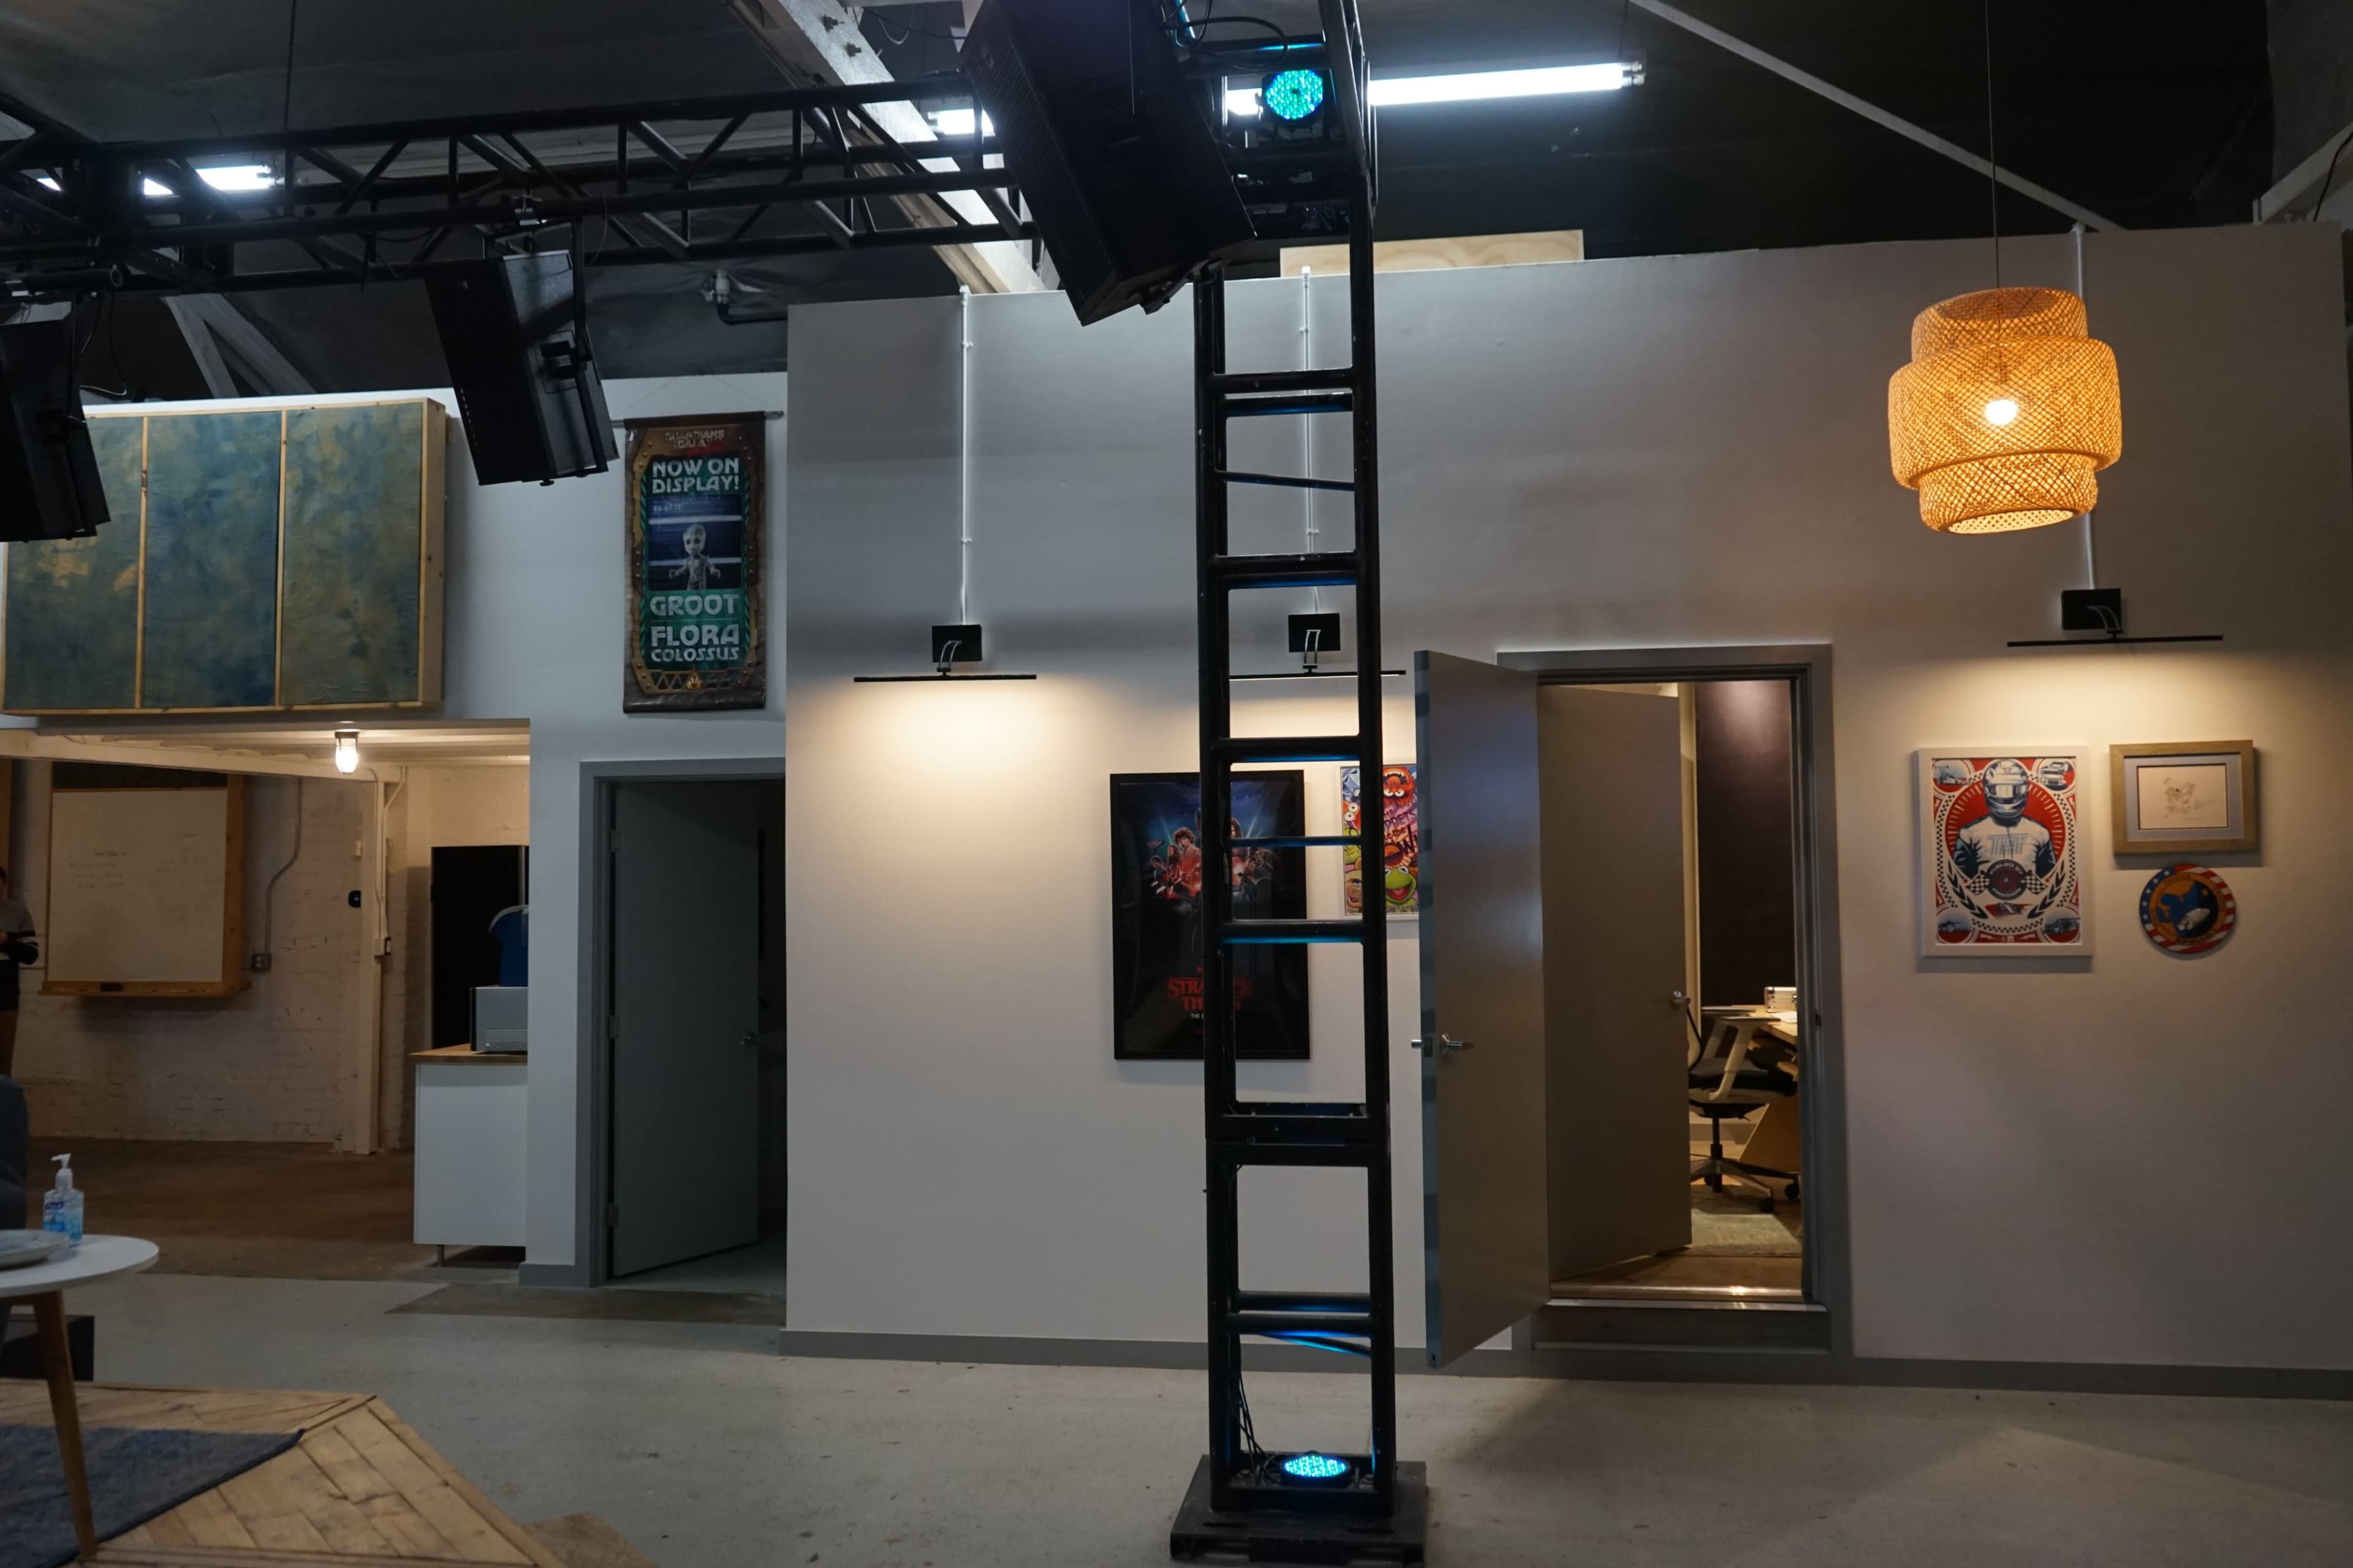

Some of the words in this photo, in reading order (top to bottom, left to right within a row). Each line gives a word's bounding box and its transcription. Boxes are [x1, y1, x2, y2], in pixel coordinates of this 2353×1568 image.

[653, 460, 703, 477] NOW
[708, 458, 739, 474] ON
[653, 475, 739, 494] DISPLAY!
[650, 594, 740, 616] GROOT
[651, 624, 740, 646] FLORA
[651, 647, 740, 662] COLOSSUS
[1393, 828, 1406, 838] the
